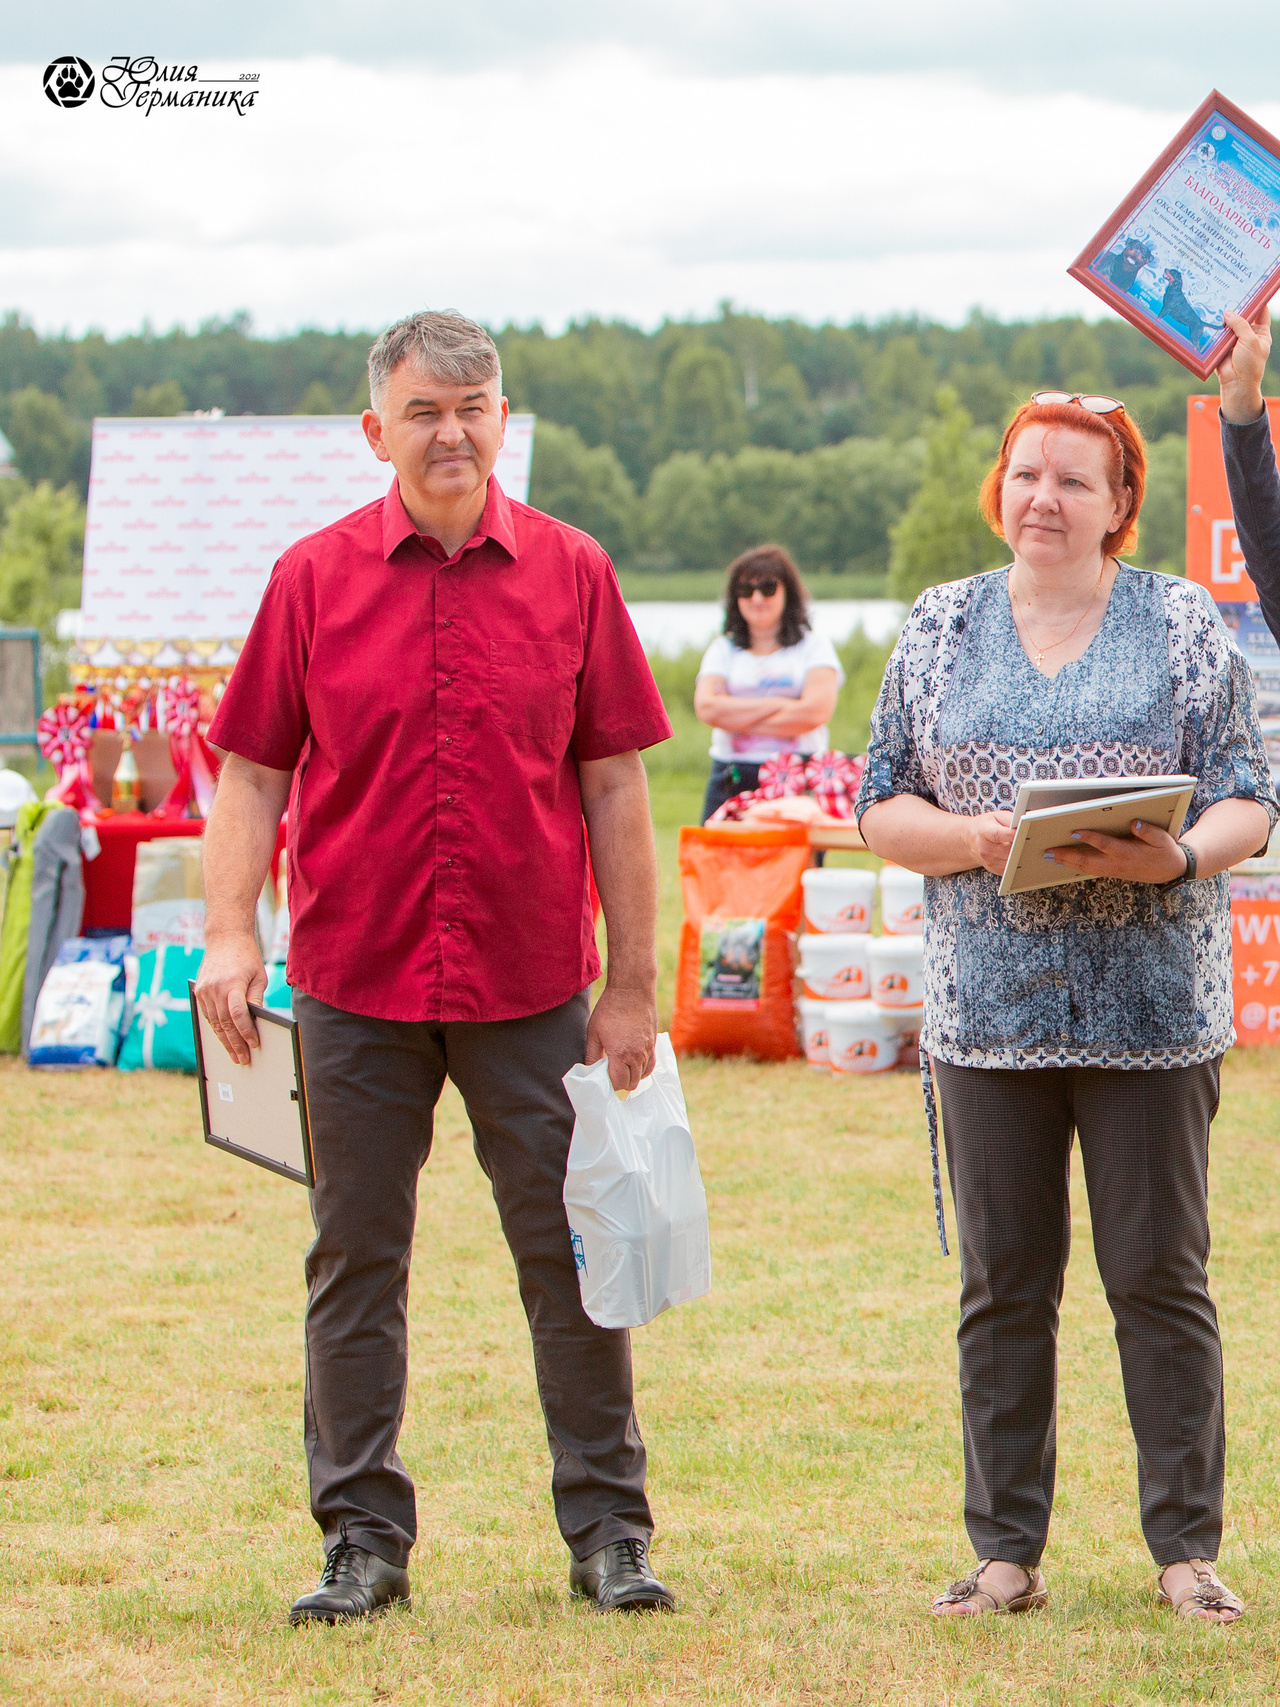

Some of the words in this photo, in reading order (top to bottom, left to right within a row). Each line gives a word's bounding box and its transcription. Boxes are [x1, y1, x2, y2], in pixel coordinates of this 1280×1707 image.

[1206, 172, 1231, 193] КУБОК
[1218, 171, 1270, 213] РОТВЕЙЛЕРОВ
[1234, 174, 1279, 211] ЧЕМПИОНАТ
[1173, 199, 1201, 223] СЕМЬЯ
[1181, 174, 1274, 251] БЛАГОДАРНОСТЬ
[1199, 206, 1240, 239] НАГРАЖДАЕТСЯ
[1154, 197, 1190, 227] ОКСАНА,
[1188, 224, 1211, 244] КИРА
[1214, 244, 1253, 278] МАГОМЕД
